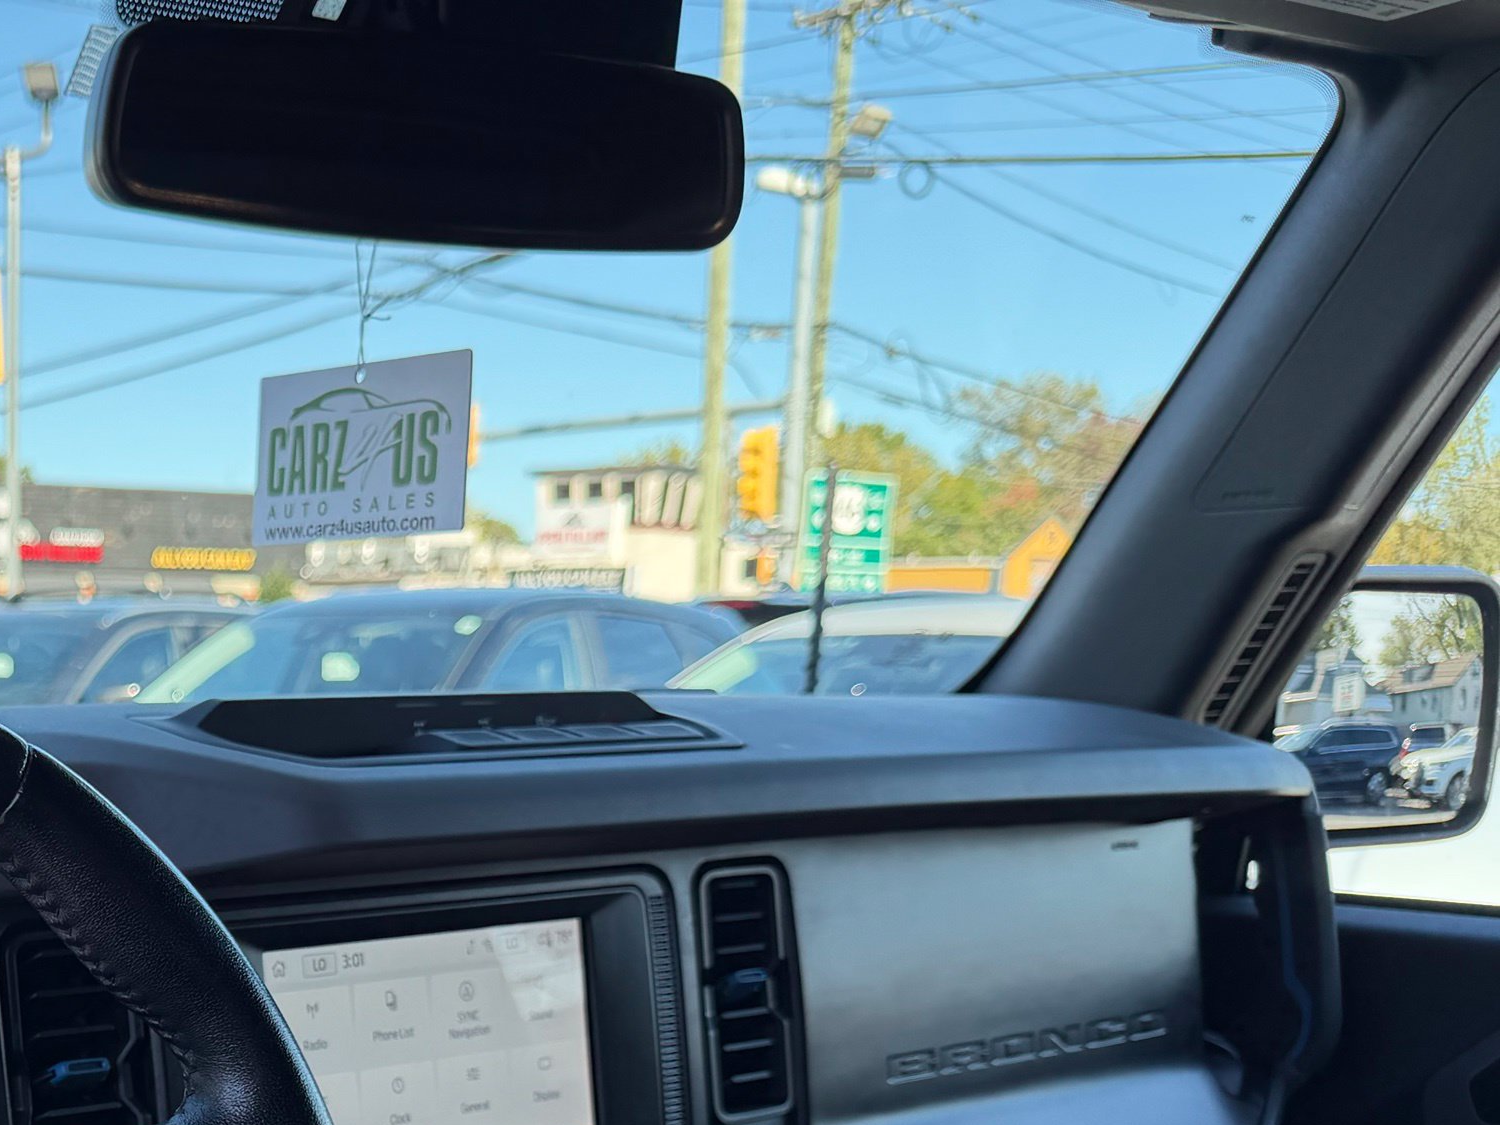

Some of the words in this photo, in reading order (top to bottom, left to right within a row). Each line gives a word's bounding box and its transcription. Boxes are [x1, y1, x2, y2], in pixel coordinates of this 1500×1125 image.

[267, 418, 349, 497] CARZ
[391, 409, 440, 488] US
[267, 501, 328, 520] AUTO
[352, 492, 435, 513] SALES
[264, 514, 436, 541] www.carz4usauto.com
[342, 952, 365, 970] 3:01
[886, 1008, 1167, 1085] BRONCO
[390, 1113, 411, 1125] Clock
